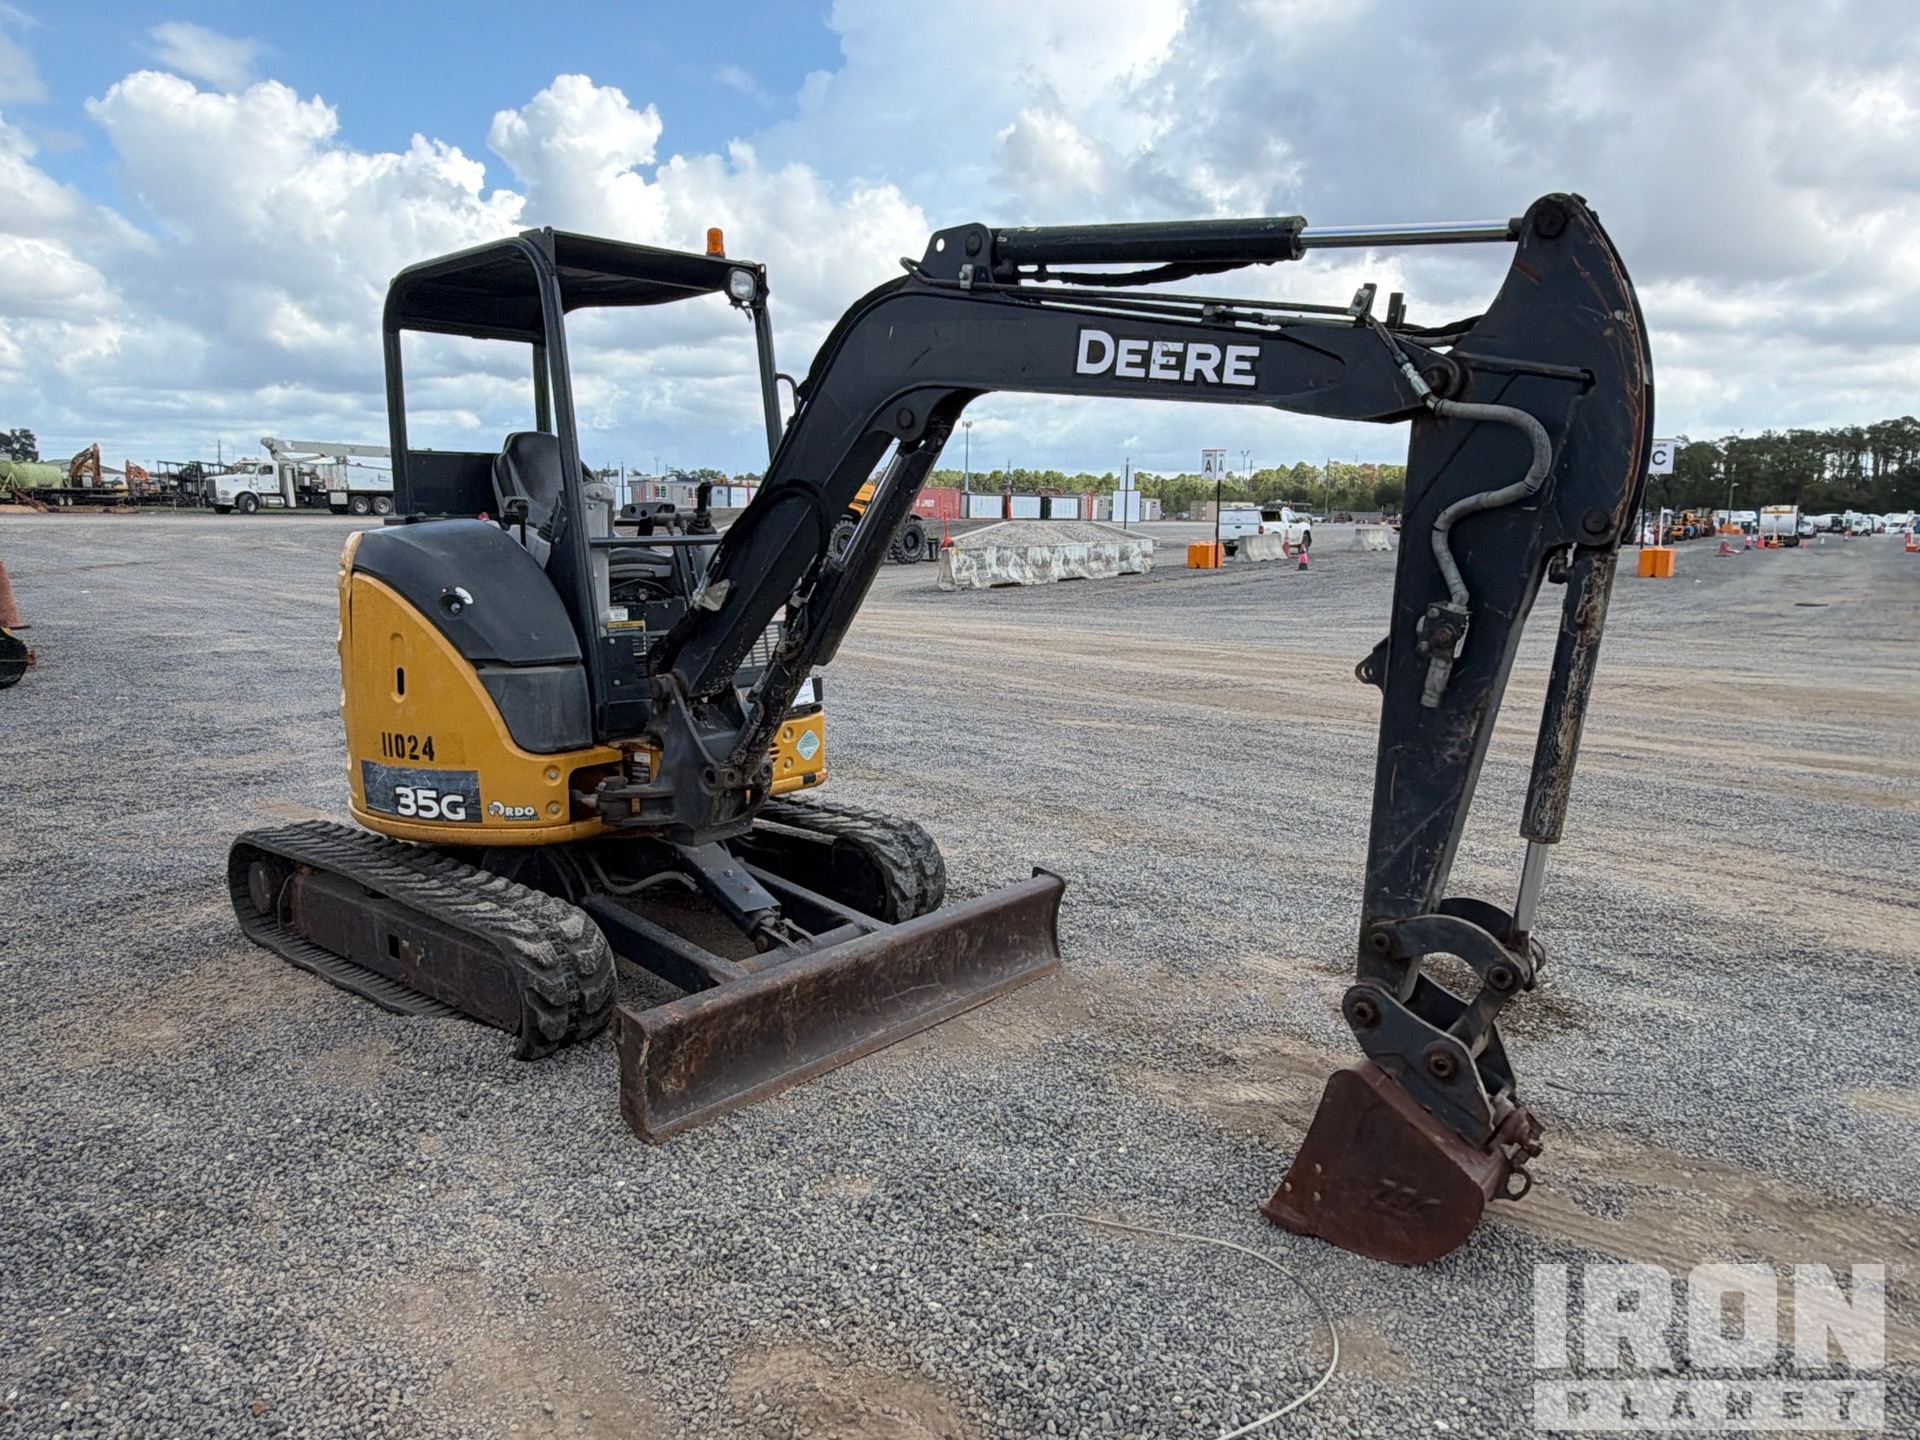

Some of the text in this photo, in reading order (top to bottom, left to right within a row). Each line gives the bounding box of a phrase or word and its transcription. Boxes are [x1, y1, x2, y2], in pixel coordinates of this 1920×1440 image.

[1076, 329, 1260, 386] DEERE
[1204, 459, 1213, 473] A
[1217, 459, 1224, 473] A
[1652, 450, 1667, 466] C
[381, 732, 435, 761] 11024
[395, 786, 466, 820] 35G
[505, 806, 535, 816] RDO
